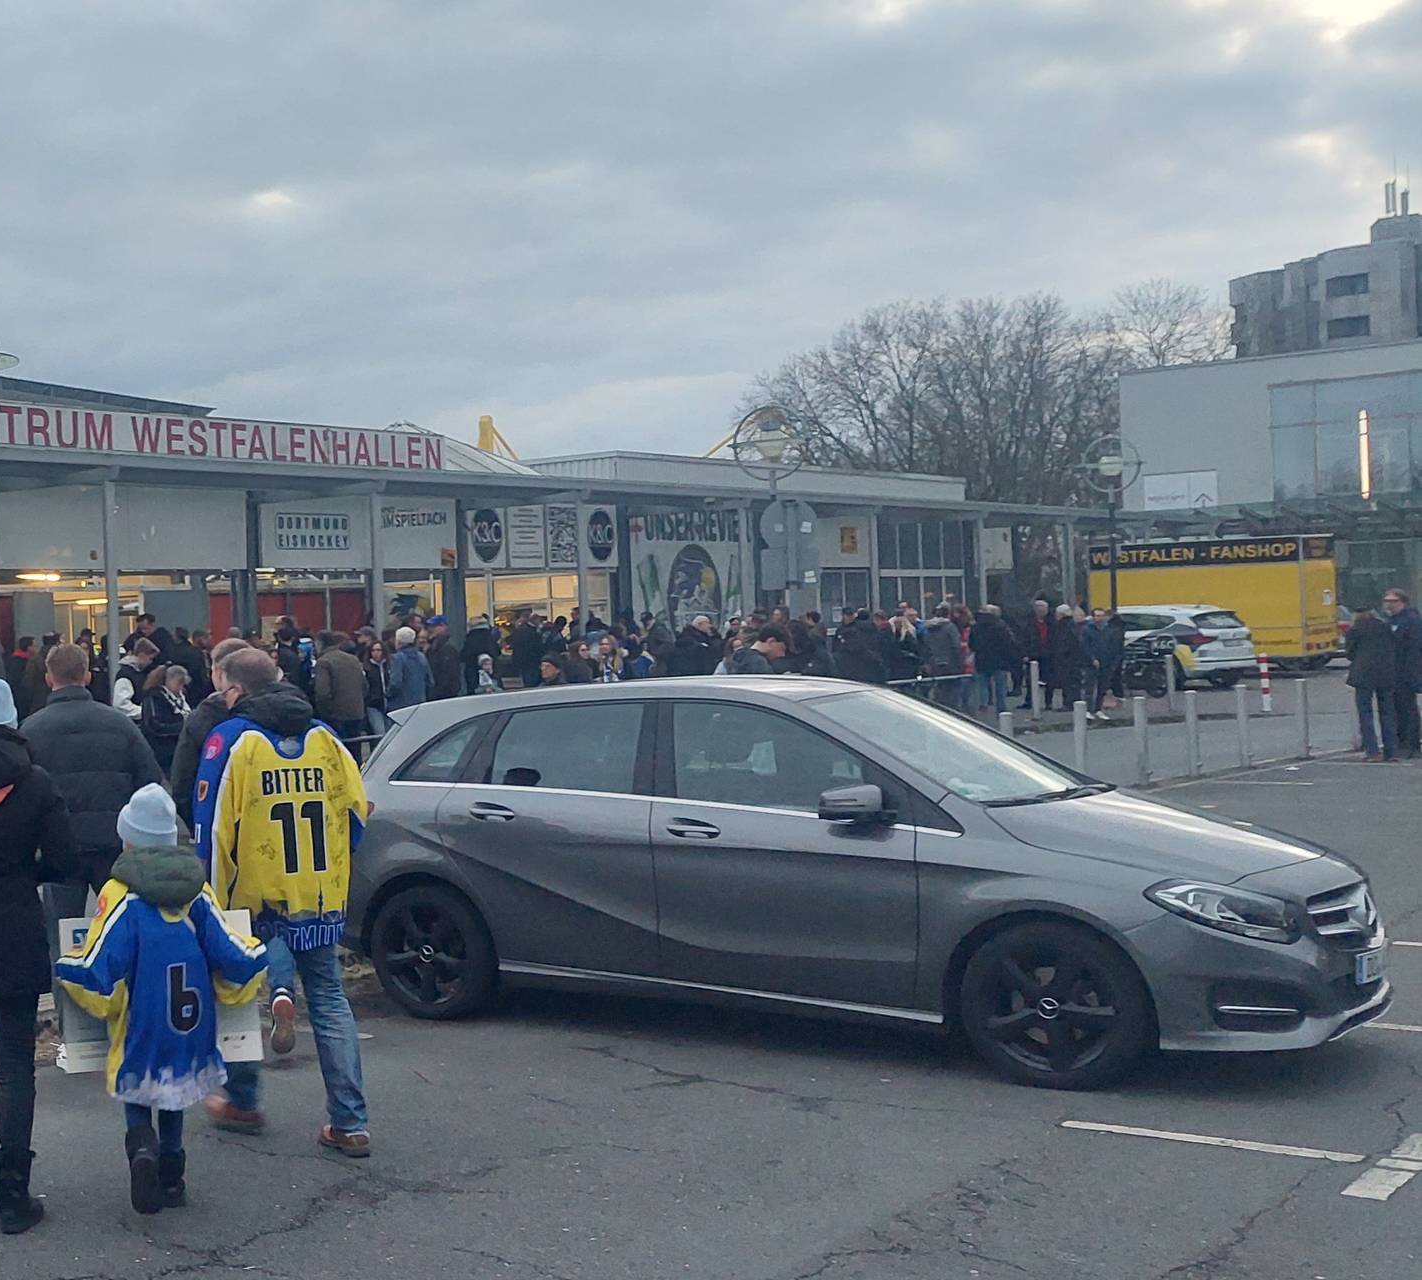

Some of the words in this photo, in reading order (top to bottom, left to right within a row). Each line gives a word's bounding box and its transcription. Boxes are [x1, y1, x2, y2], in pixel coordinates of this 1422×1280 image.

[130, 415, 442, 470] WESTFALENHALLEN
[278, 516, 348, 530] DORTMUND
[644, 512, 694, 541] UNSER
[278, 533, 348, 548] EISHOCKEY
[1092, 547, 1195, 564] WSTFALEN
[1210, 542, 1297, 560] FANSHOP
[261, 767, 325, 796] BITTER
[269, 800, 328, 874] 11
[166, 962, 202, 1035] 6
